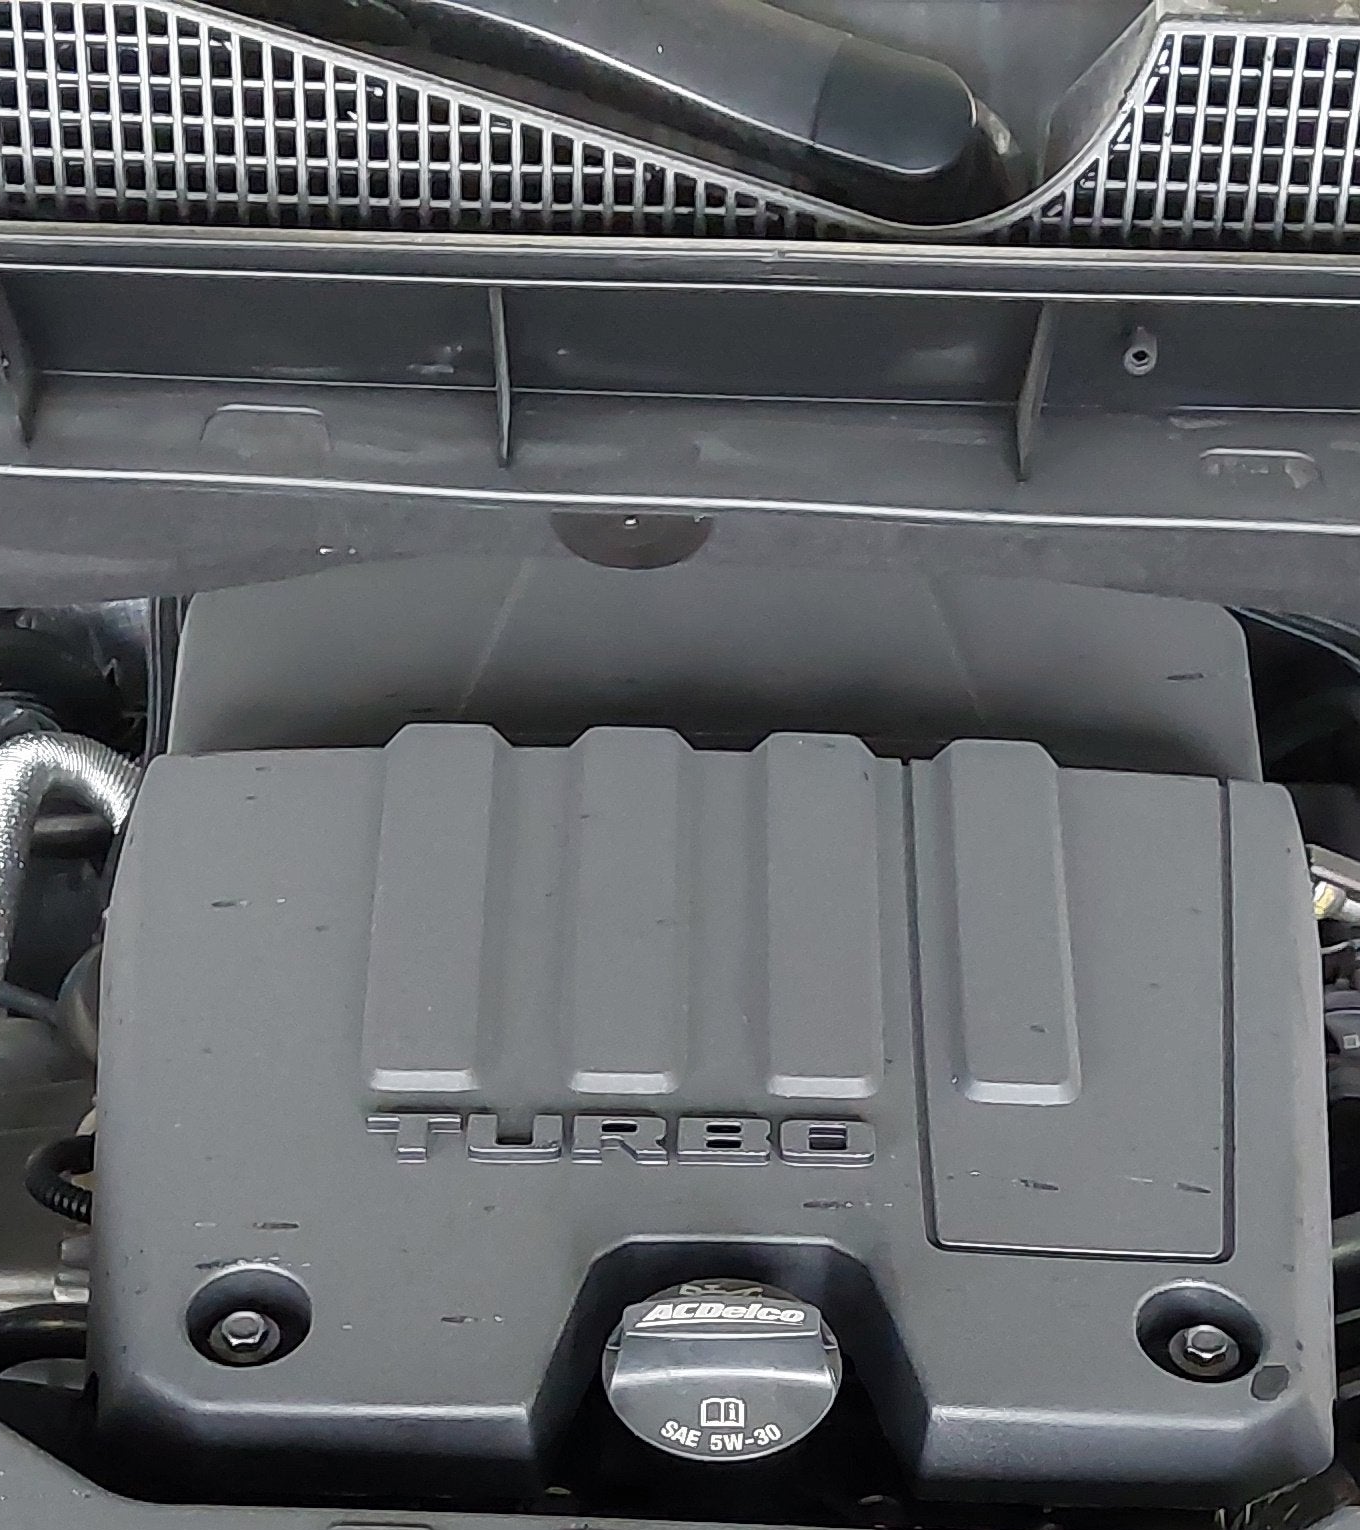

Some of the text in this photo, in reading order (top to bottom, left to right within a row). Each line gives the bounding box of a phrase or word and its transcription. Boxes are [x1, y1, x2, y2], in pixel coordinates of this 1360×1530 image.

[366, 1112, 876, 1168] TURBO
[642, 1302, 805, 1323] ACDelco
[660, 1420, 782, 1451] SAE 5W-30
